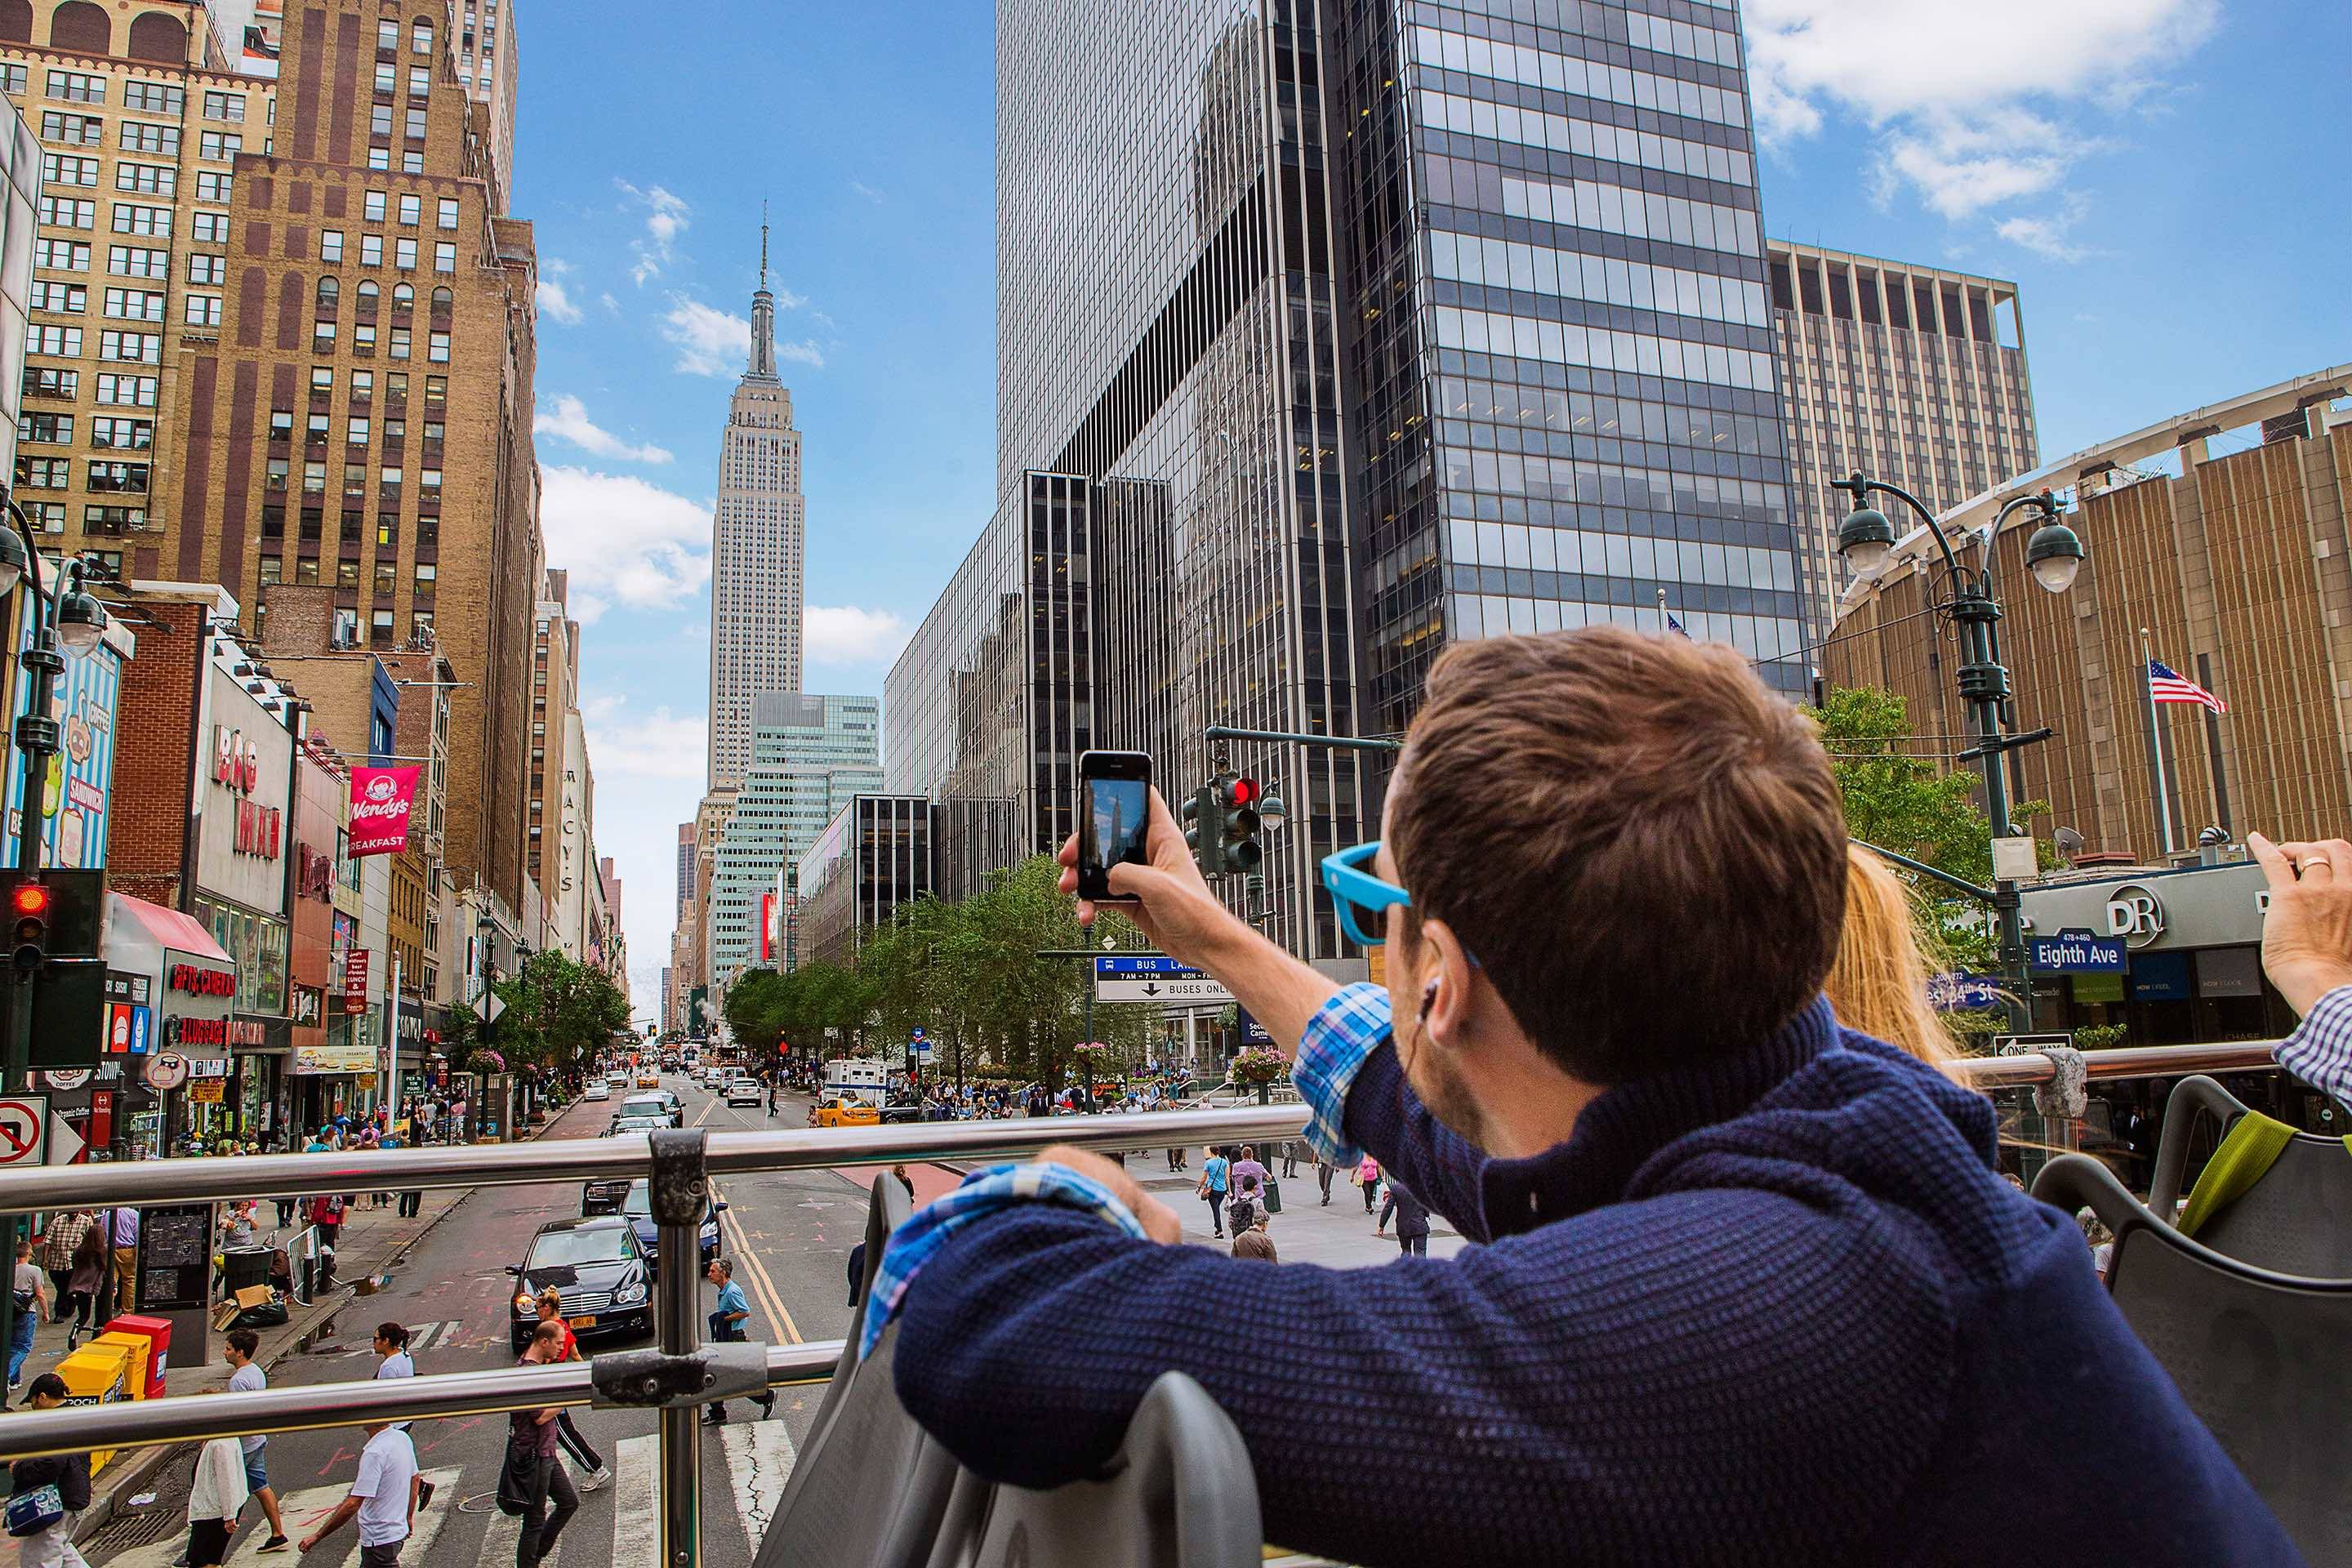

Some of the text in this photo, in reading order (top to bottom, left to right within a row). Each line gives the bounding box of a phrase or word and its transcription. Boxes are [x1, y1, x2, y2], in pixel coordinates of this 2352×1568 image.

[70, 779, 103, 813] SANDWICH
[349, 797, 409, 822] Wendy's
[2106, 897, 2164, 936] DR
[1137, 960, 1156, 969] BUS
[2038, 944, 2118, 968] Eighth Ave
[1169, 985, 1201, 994] BUSES
[1927, 986, 1946, 1004] est
[1977, 982, 1993, 1001] St
[75, 1107, 90, 1116] Coffee
